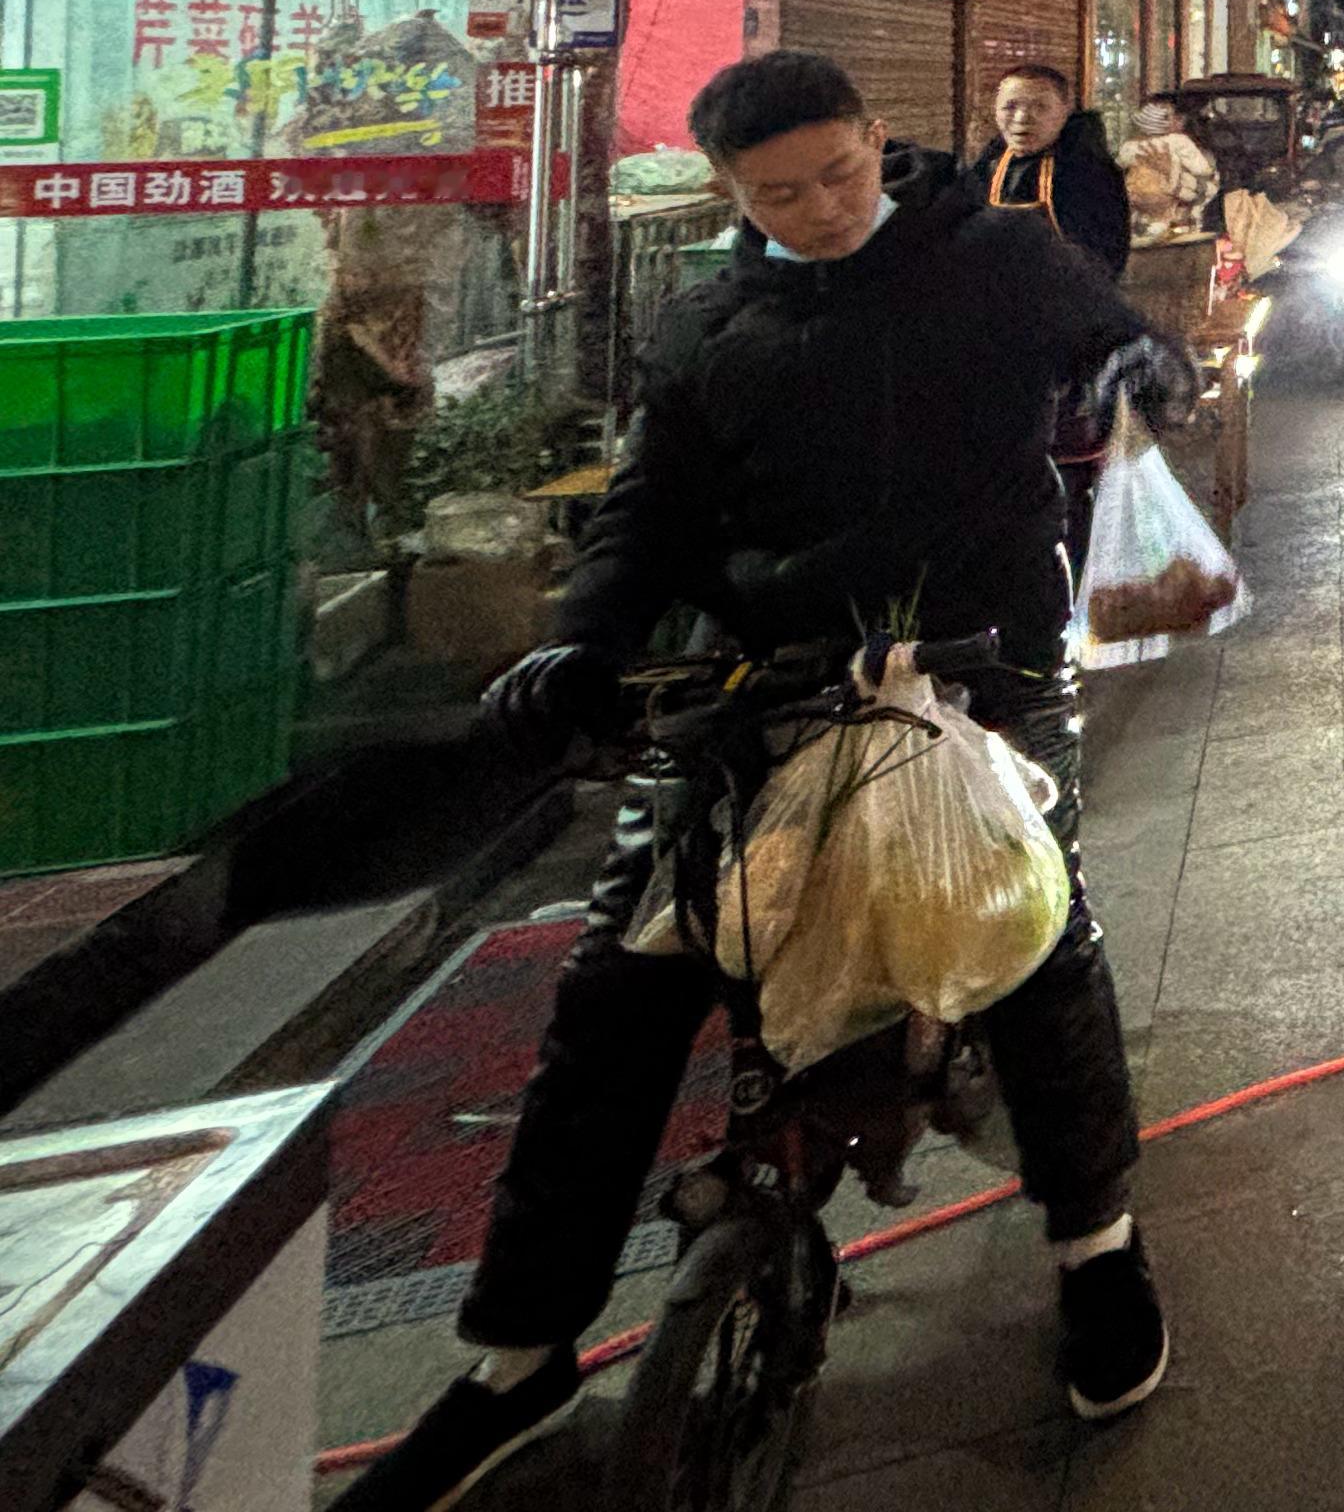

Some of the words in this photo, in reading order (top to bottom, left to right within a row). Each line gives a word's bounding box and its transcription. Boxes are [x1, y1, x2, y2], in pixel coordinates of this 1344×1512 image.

[486, 68, 536, 108] 推
[34, 170, 246, 208] 中国劲酒
